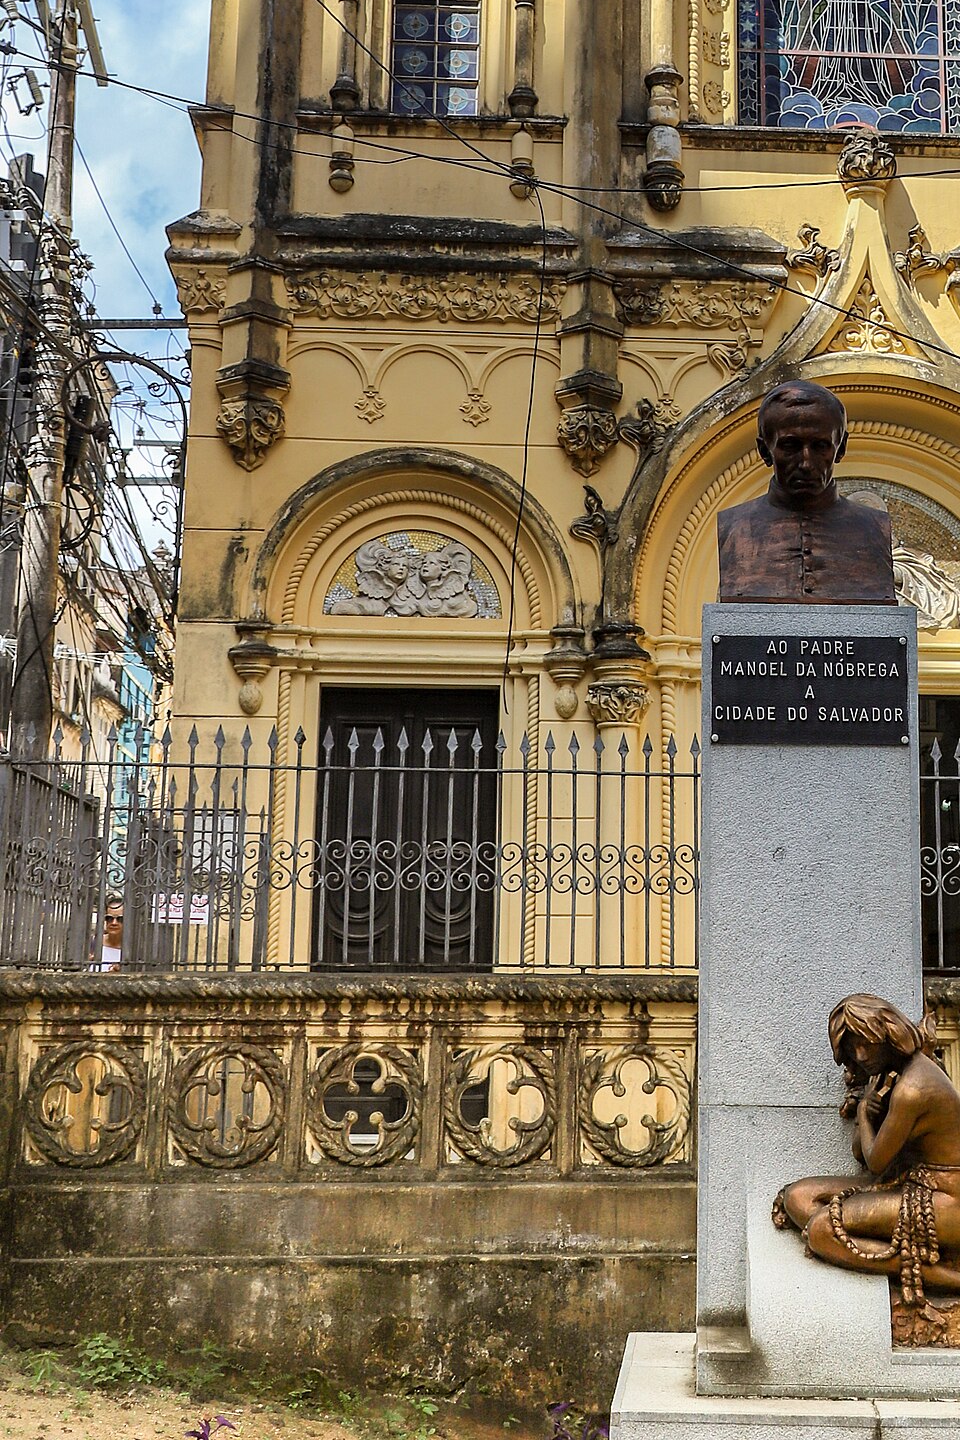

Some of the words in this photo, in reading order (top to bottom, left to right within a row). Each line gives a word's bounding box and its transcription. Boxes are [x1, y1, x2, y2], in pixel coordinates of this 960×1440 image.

[766, 640, 788, 655] AO
[800, 641, 855, 656] PADRE
[720, 661, 788, 677] MANOEL
[796, 662, 817, 677] DA
[823, 658, 900, 678] NÓBREGA
[804, 684, 815, 699] A
[714, 705, 776, 721] CIDADE
[787, 707, 808, 721] DO
[818, 707, 904, 722] SALVADOR
